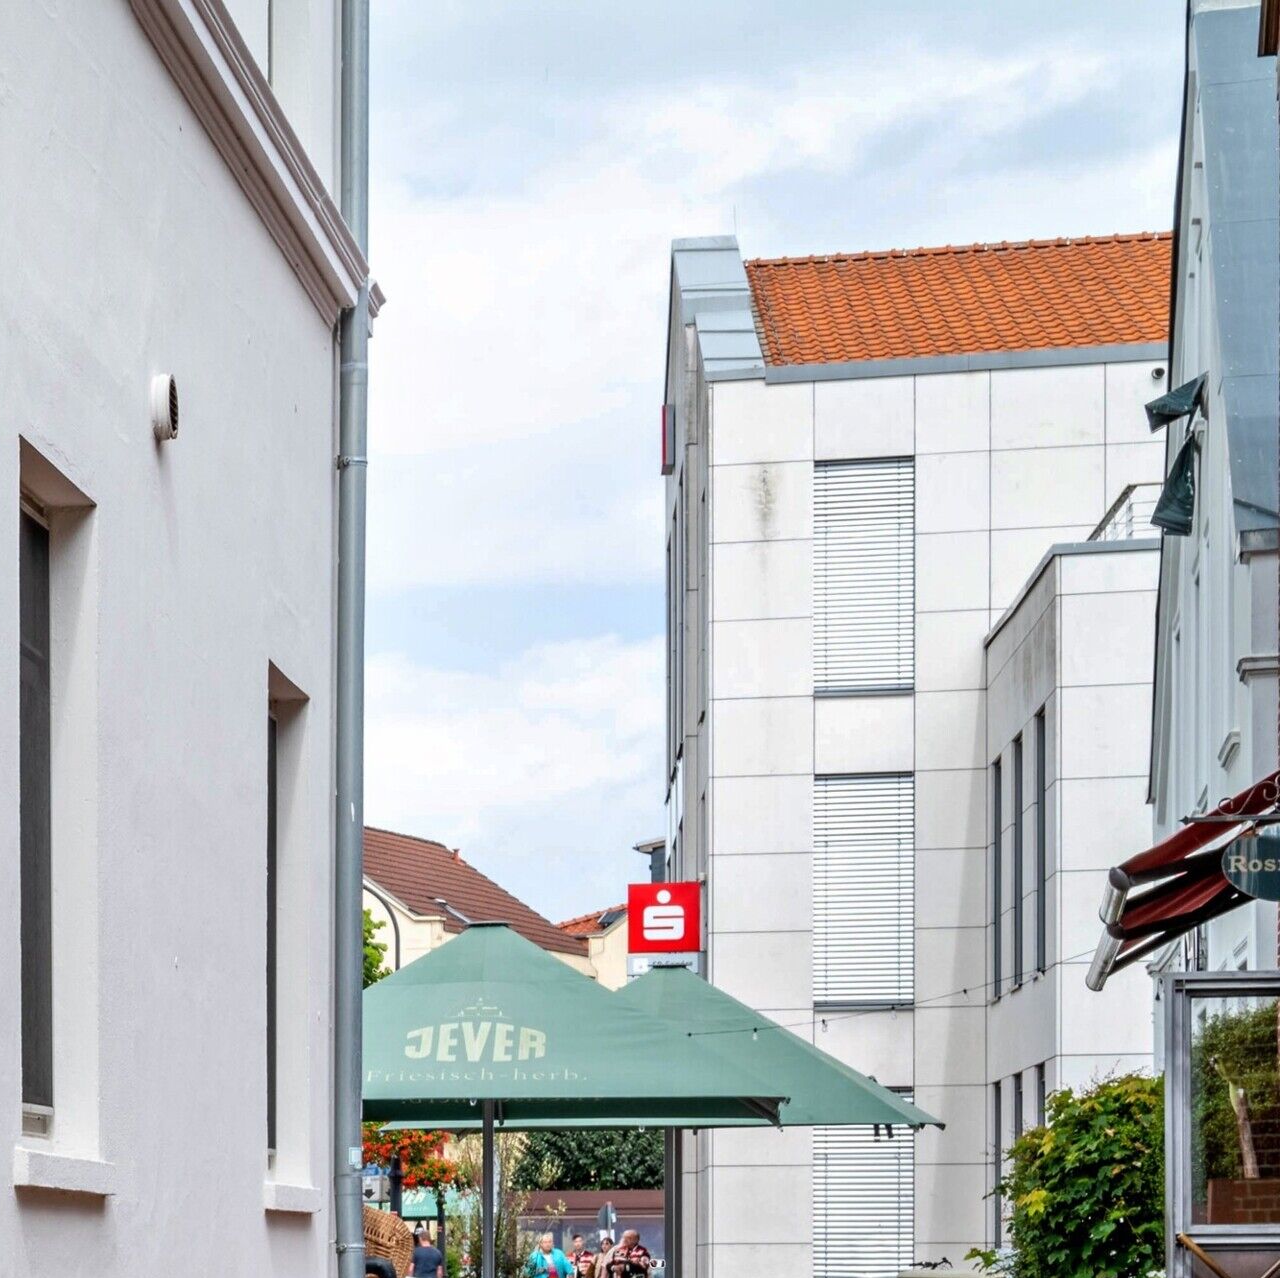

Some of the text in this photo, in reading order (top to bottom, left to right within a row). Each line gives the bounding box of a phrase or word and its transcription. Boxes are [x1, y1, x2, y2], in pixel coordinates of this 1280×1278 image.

[1228, 855, 1280, 872] Ros
[404, 1021, 547, 1062] JEVER
[366, 1068, 588, 1082] Friesisch-herb.
